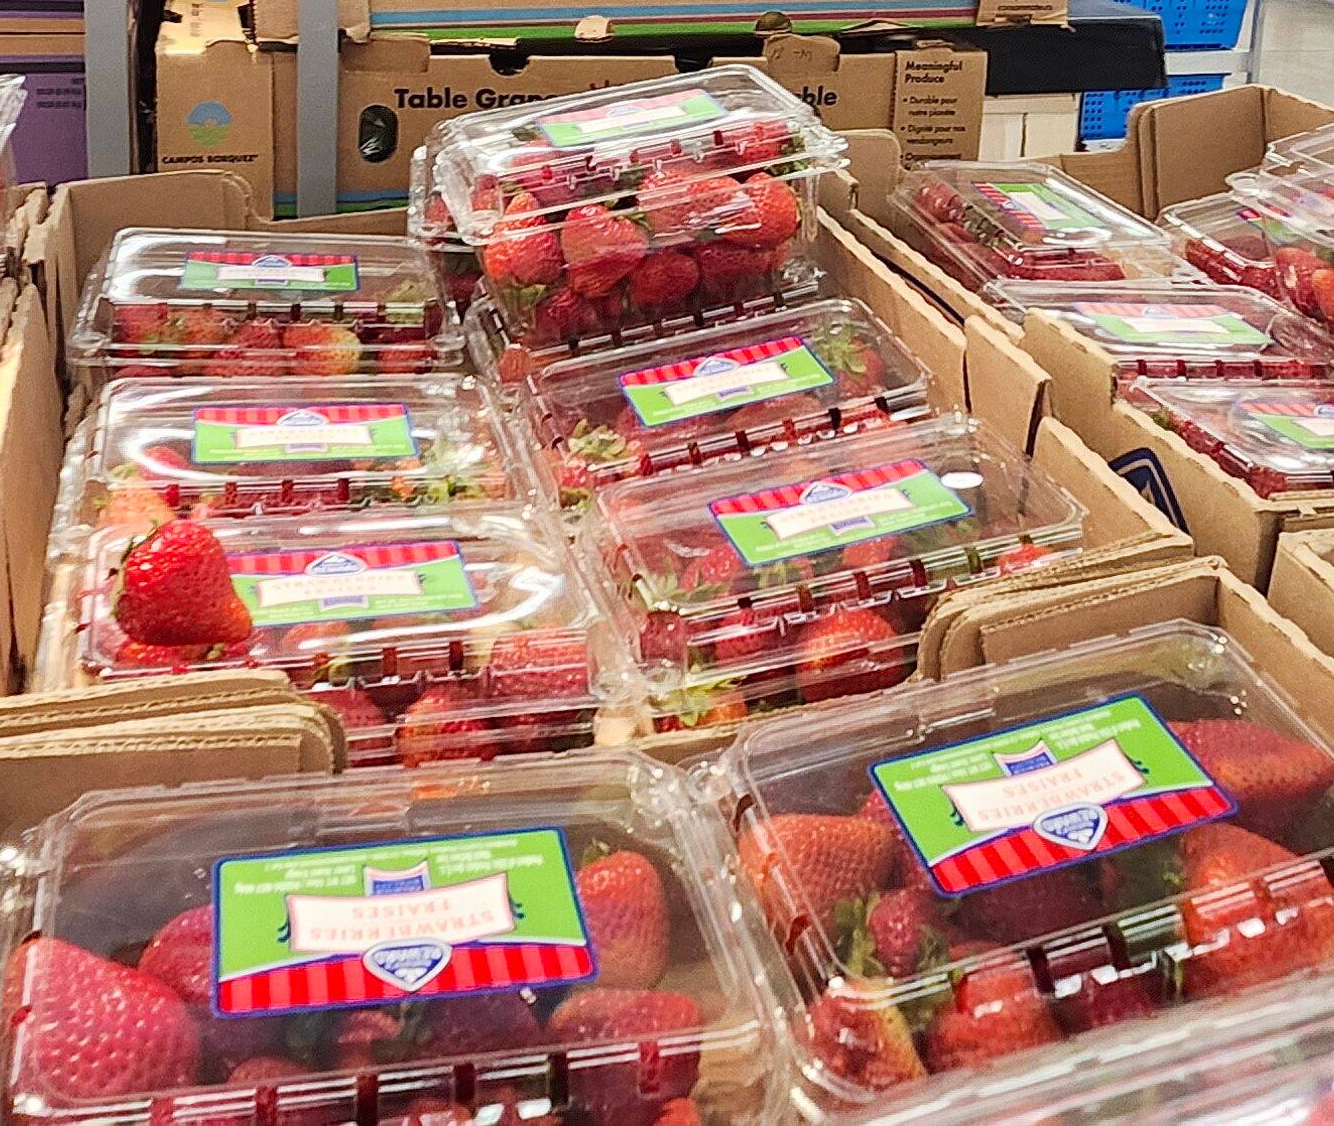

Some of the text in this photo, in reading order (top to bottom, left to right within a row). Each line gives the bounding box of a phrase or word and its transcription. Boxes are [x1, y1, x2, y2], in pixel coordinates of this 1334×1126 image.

[905, 60, 963, 73] Meaningful
[904, 73, 945, 84] Produce
[394, 87, 467, 109] Table
[162, 155, 204, 164] CAMPOS
[1003, 766, 1085, 800] FRAISES
[976, 771, 1126, 823] STRAWBERRIES
[352, 897, 456, 920] FRAISES
[309, 908, 495, 941] STRAWBERRIES
